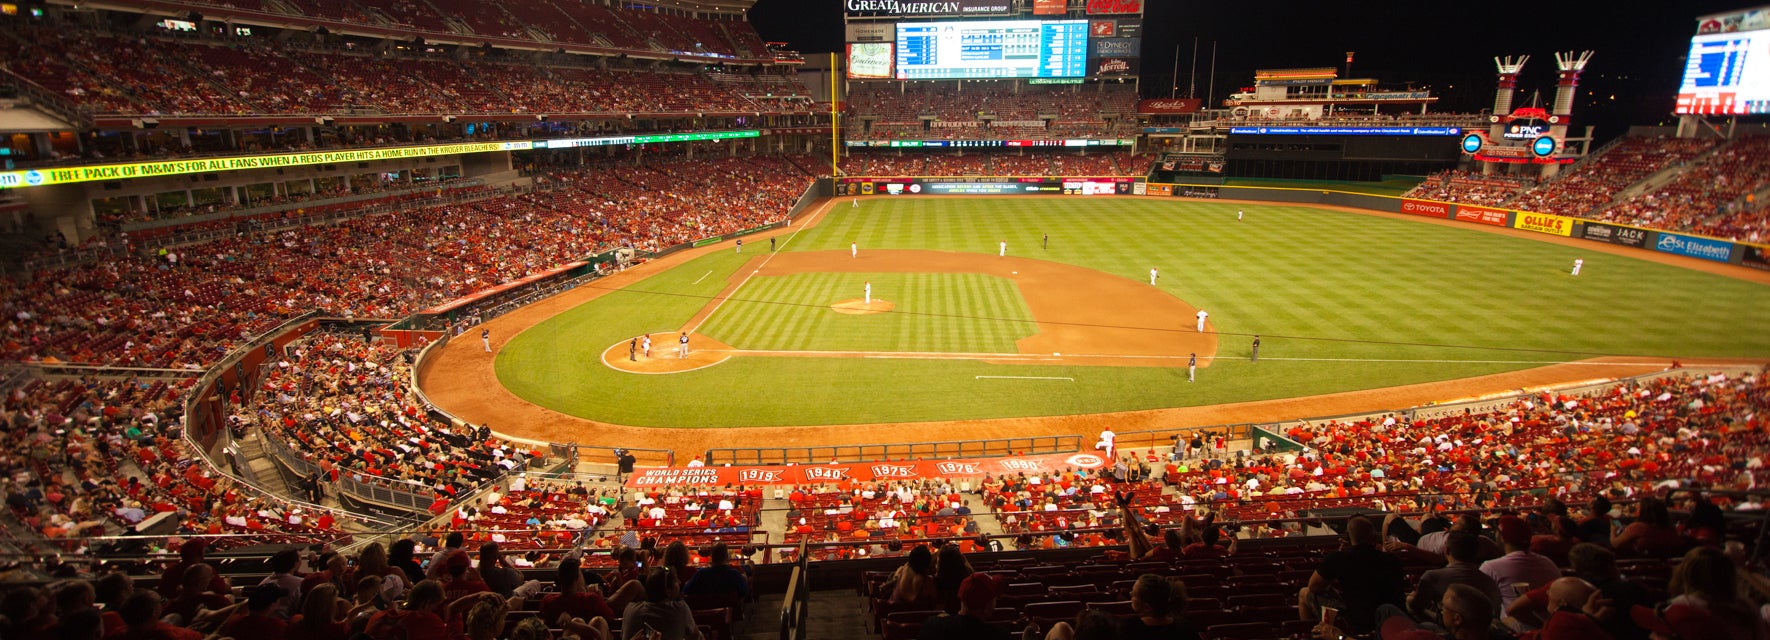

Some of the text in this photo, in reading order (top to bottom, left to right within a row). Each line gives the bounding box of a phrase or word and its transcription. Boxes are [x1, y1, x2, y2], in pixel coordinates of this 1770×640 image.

[1520, 126, 1541, 134] PNC
[51, 168, 82, 181] FREE
[84, 166, 119, 179] PACK
[123, 165, 139, 177] OF
[142, 162, 185, 175] M&M'S
[186, 160, 207, 172] FOR
[209, 159, 230, 170] ALL
[230, 157, 257, 169] FANS
[259, 156, 290, 166] WHEN
[292, 155, 299, 164] A
[301, 153, 324, 163] REDS
[325, 151, 355, 161] PLAYER
[357, 150, 374, 160] HITS
[375, 150, 381, 158] A
[382, 149, 403, 158] HOME
[404, 148, 418, 156] RUN
[418, 147, 426, 155] IN
[428, 146, 439, 155] THE
[440, 145, 463, 154] KROGER
[1415, 203, 1445, 214] TOYOTA
[1616, 228, 1645, 240] JACK
[1686, 241, 1730, 255] Elizabeth
[940, 462, 974, 473] 1976
[1004, 460, 1038, 470] 1990
[742, 470, 773, 481] 1919
[807, 468, 841, 479] 1940
[874, 466, 908, 477] 1975
[636, 475, 718, 485] CHAMPIONS
